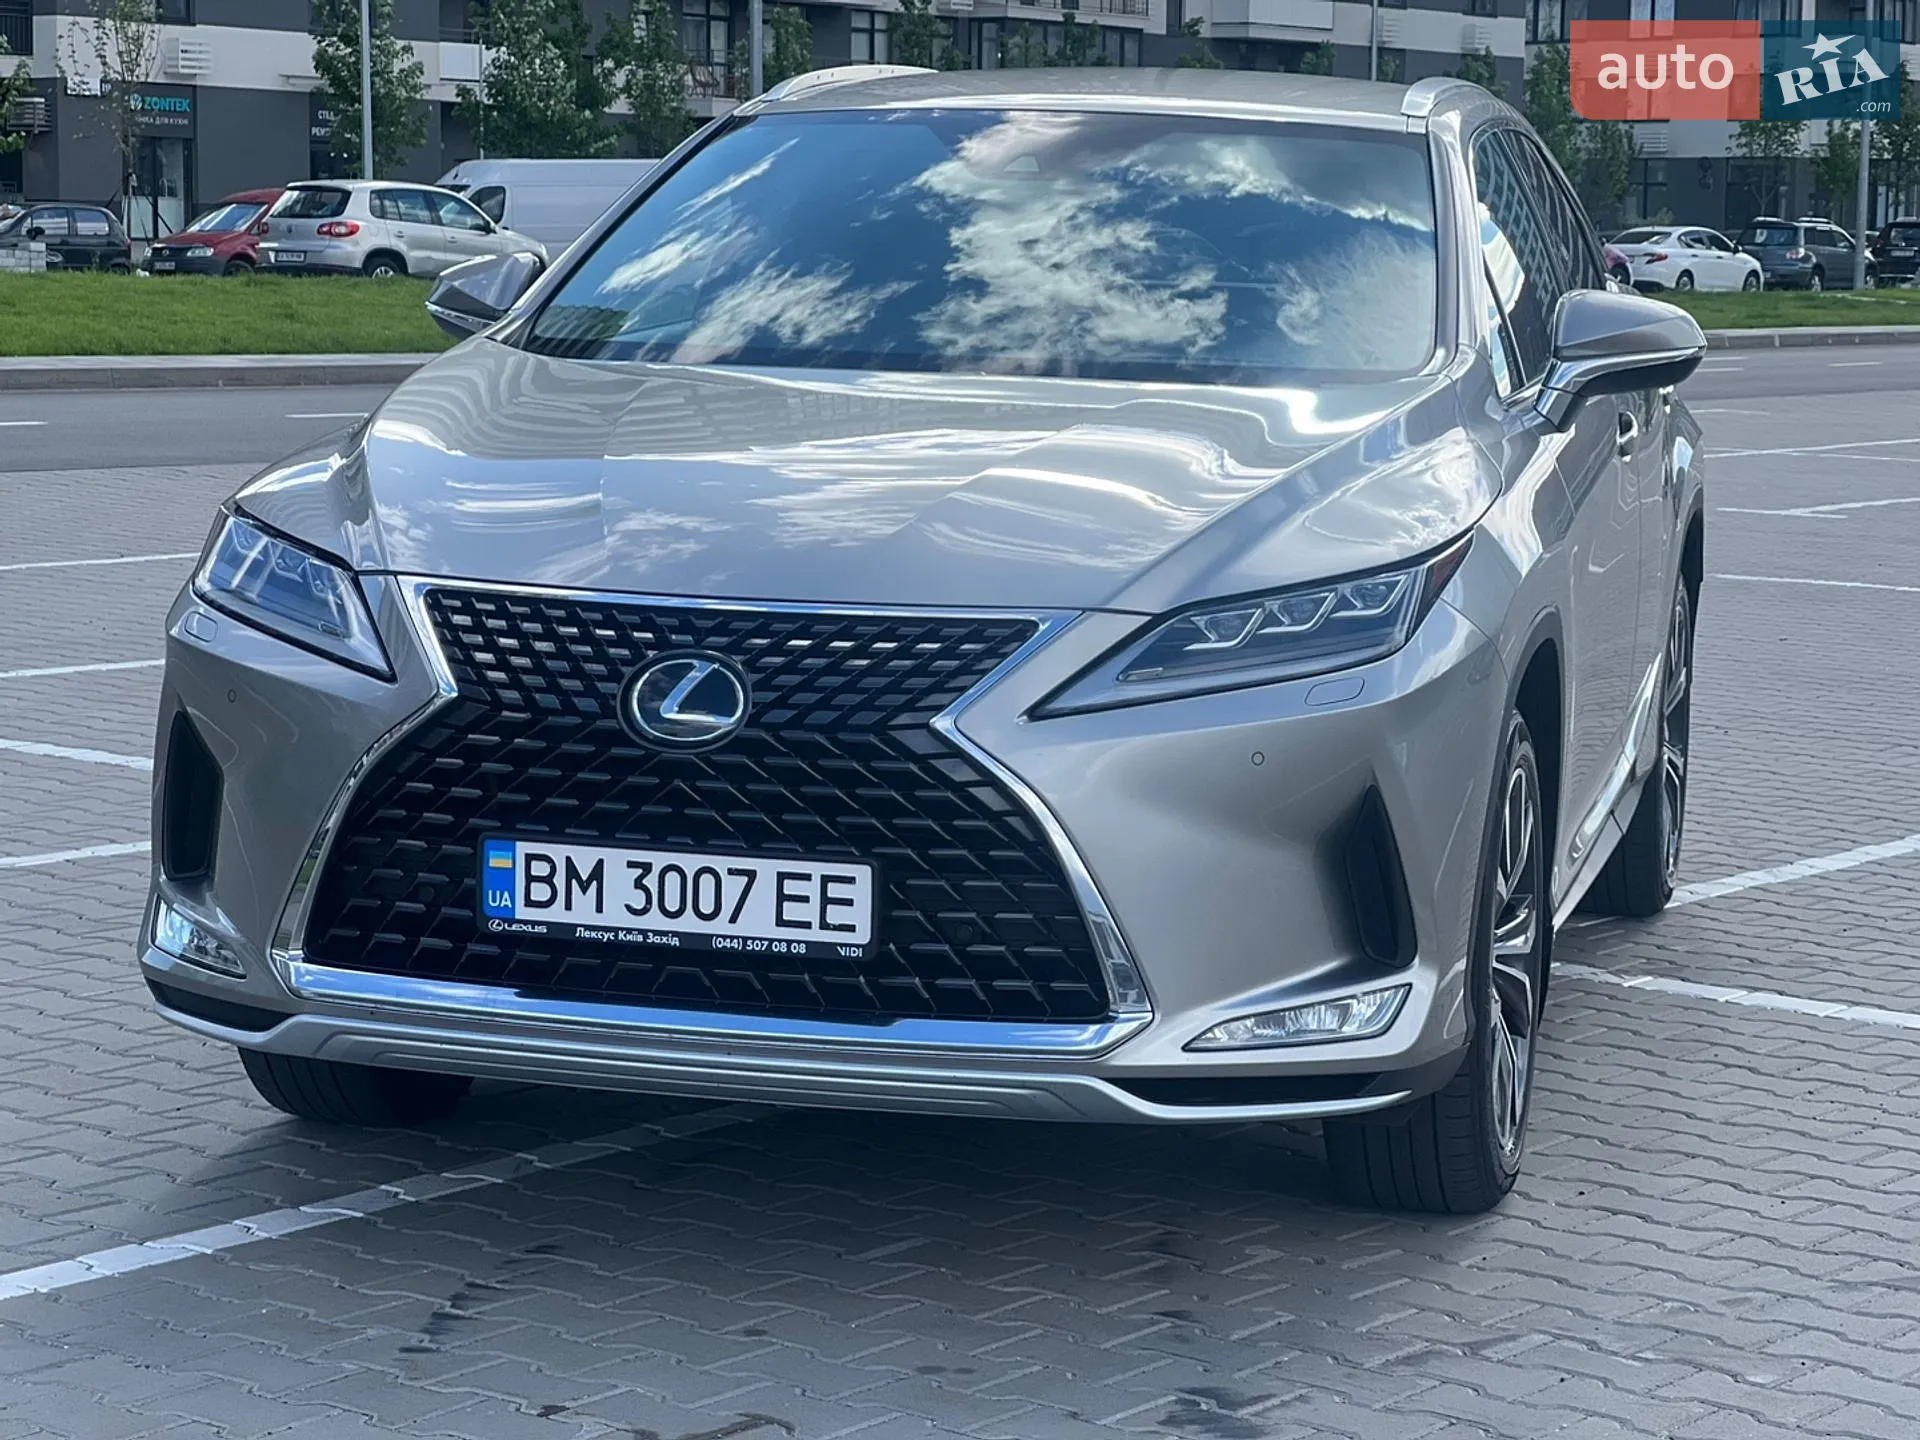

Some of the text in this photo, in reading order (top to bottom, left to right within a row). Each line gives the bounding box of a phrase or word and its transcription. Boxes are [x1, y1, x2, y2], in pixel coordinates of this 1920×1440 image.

[143, 96, 191, 112] ZONTEK
[488, 890, 512, 908] UA
[523, 852, 857, 933] BM 3007 EE
[504, 922, 548, 933] LEXUS
[575, 926, 680, 947] Лексус Київ Захід
[711, 935, 807, 954] (044) 507 08 08
[836, 945, 863, 957] VIDI
